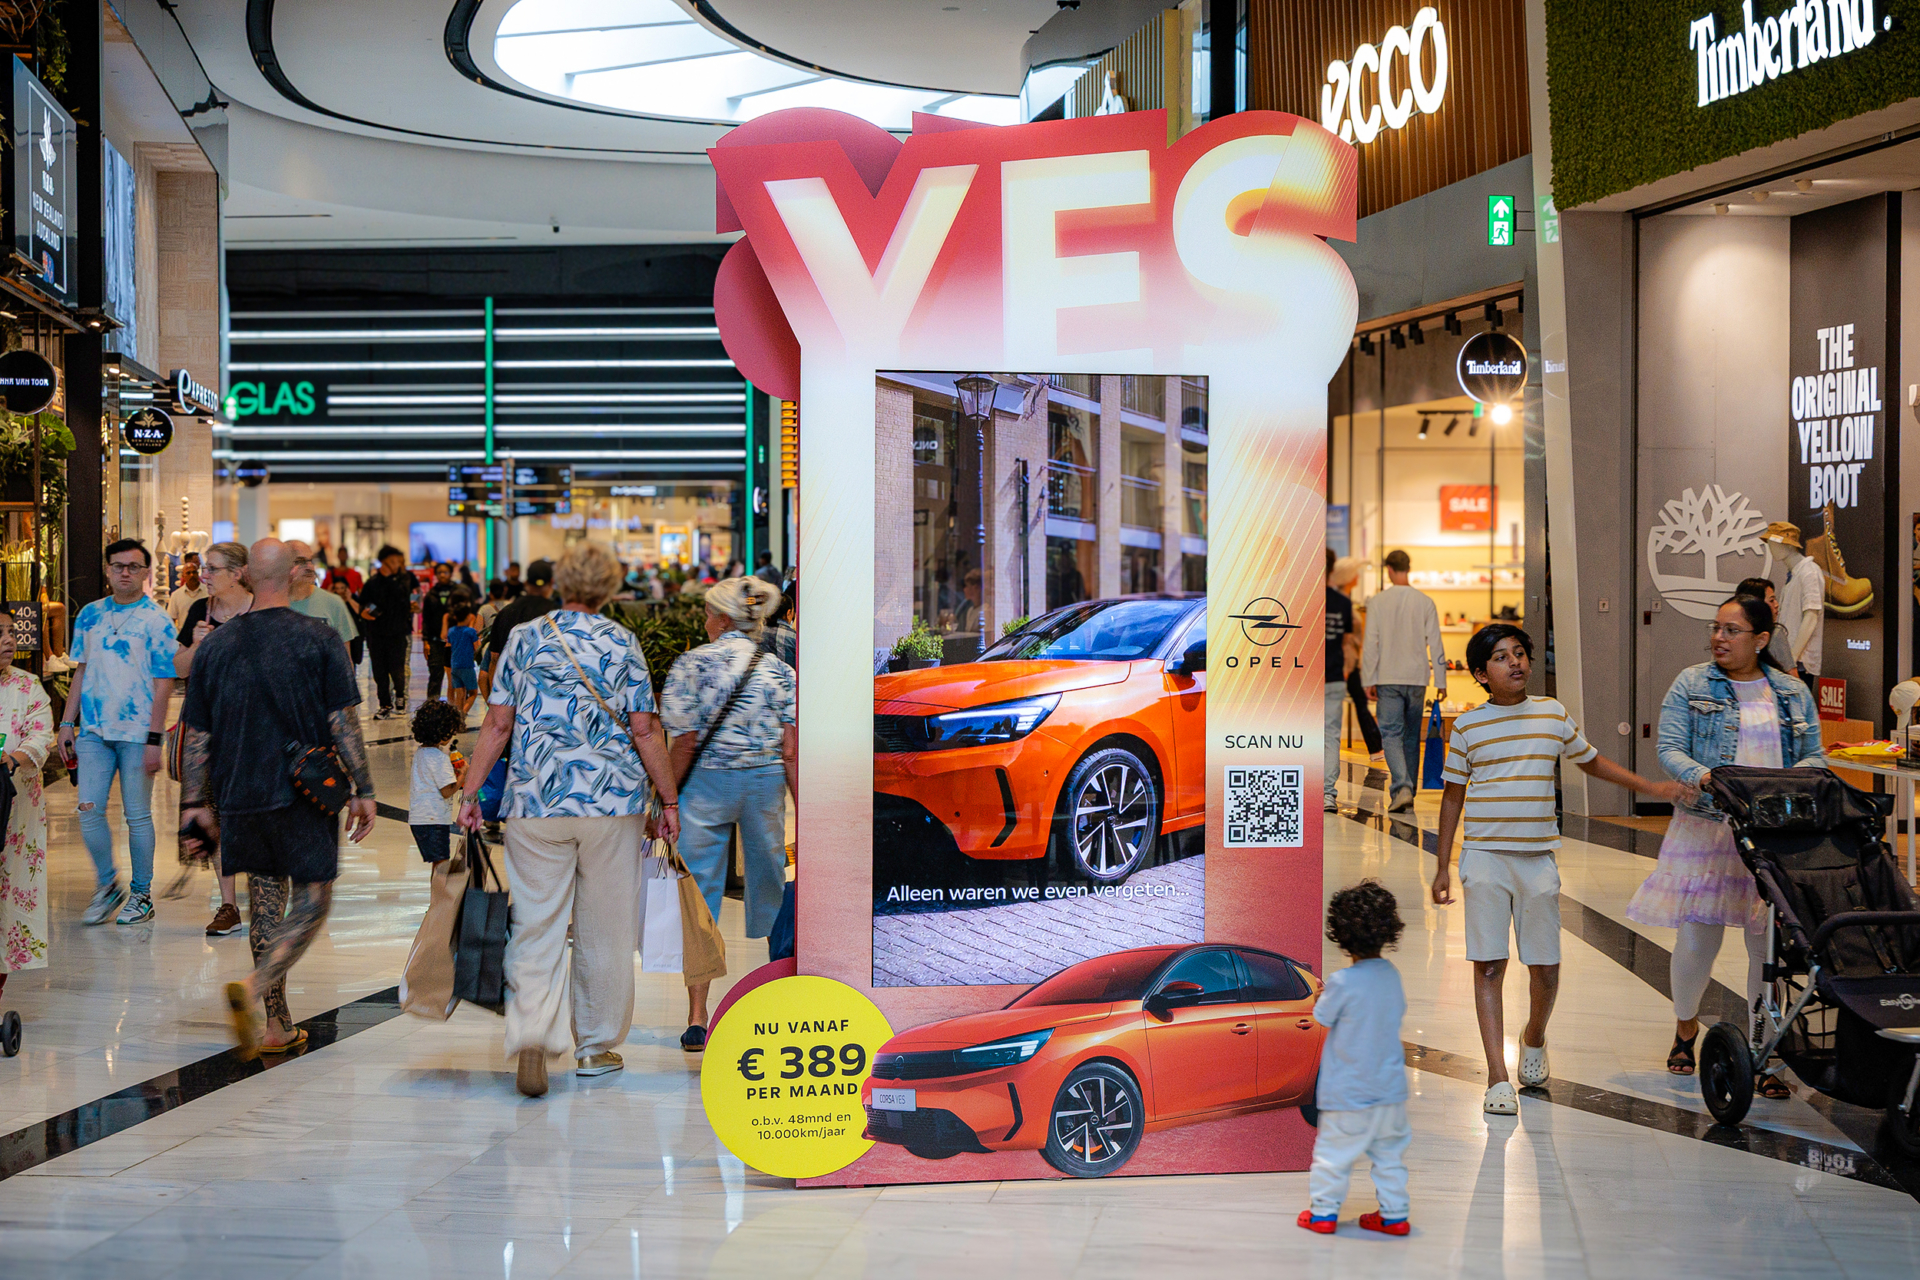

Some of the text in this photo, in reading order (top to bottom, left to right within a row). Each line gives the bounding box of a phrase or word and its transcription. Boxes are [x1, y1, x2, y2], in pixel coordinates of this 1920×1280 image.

[1689, 0, 1876, 107] Timberland
[763, 133, 1359, 385] YES
[1817, 323, 1854, 371] THE
[1466, 360, 1522, 375] Timberland
[15, 378, 30, 386] VAN
[31, 378, 49, 386] TOOR
[229, 381, 316, 416] GLAS
[1791, 367, 1881, 420] ORIGINAL
[1798, 414, 1874, 464] YELLOW
[1810, 463, 1862, 509] BOOT
[1449, 497, 1489, 512] SALE
[16, 606, 37, 618] 40%
[16, 620, 37, 631] 30%
[16, 634, 37, 645] 20%
[1226, 656, 1304, 668] OPEL
[1820, 685, 1844, 708] SALE
[1225, 735, 1304, 749] SCAN NU
[886, 882, 1190, 902] Alleen waren we even vergeten...
[754, 1019, 849, 1036] NU VANAF
[780, 1043, 866, 1080] 389
[746, 1083, 858, 1100] PER MAAND
[880, 1094, 895, 1103] CORSA
[751, 1112, 851, 1126] o.b.v. 48mnd en
[757, 1126, 846, 1140] 10.000km/jaar
